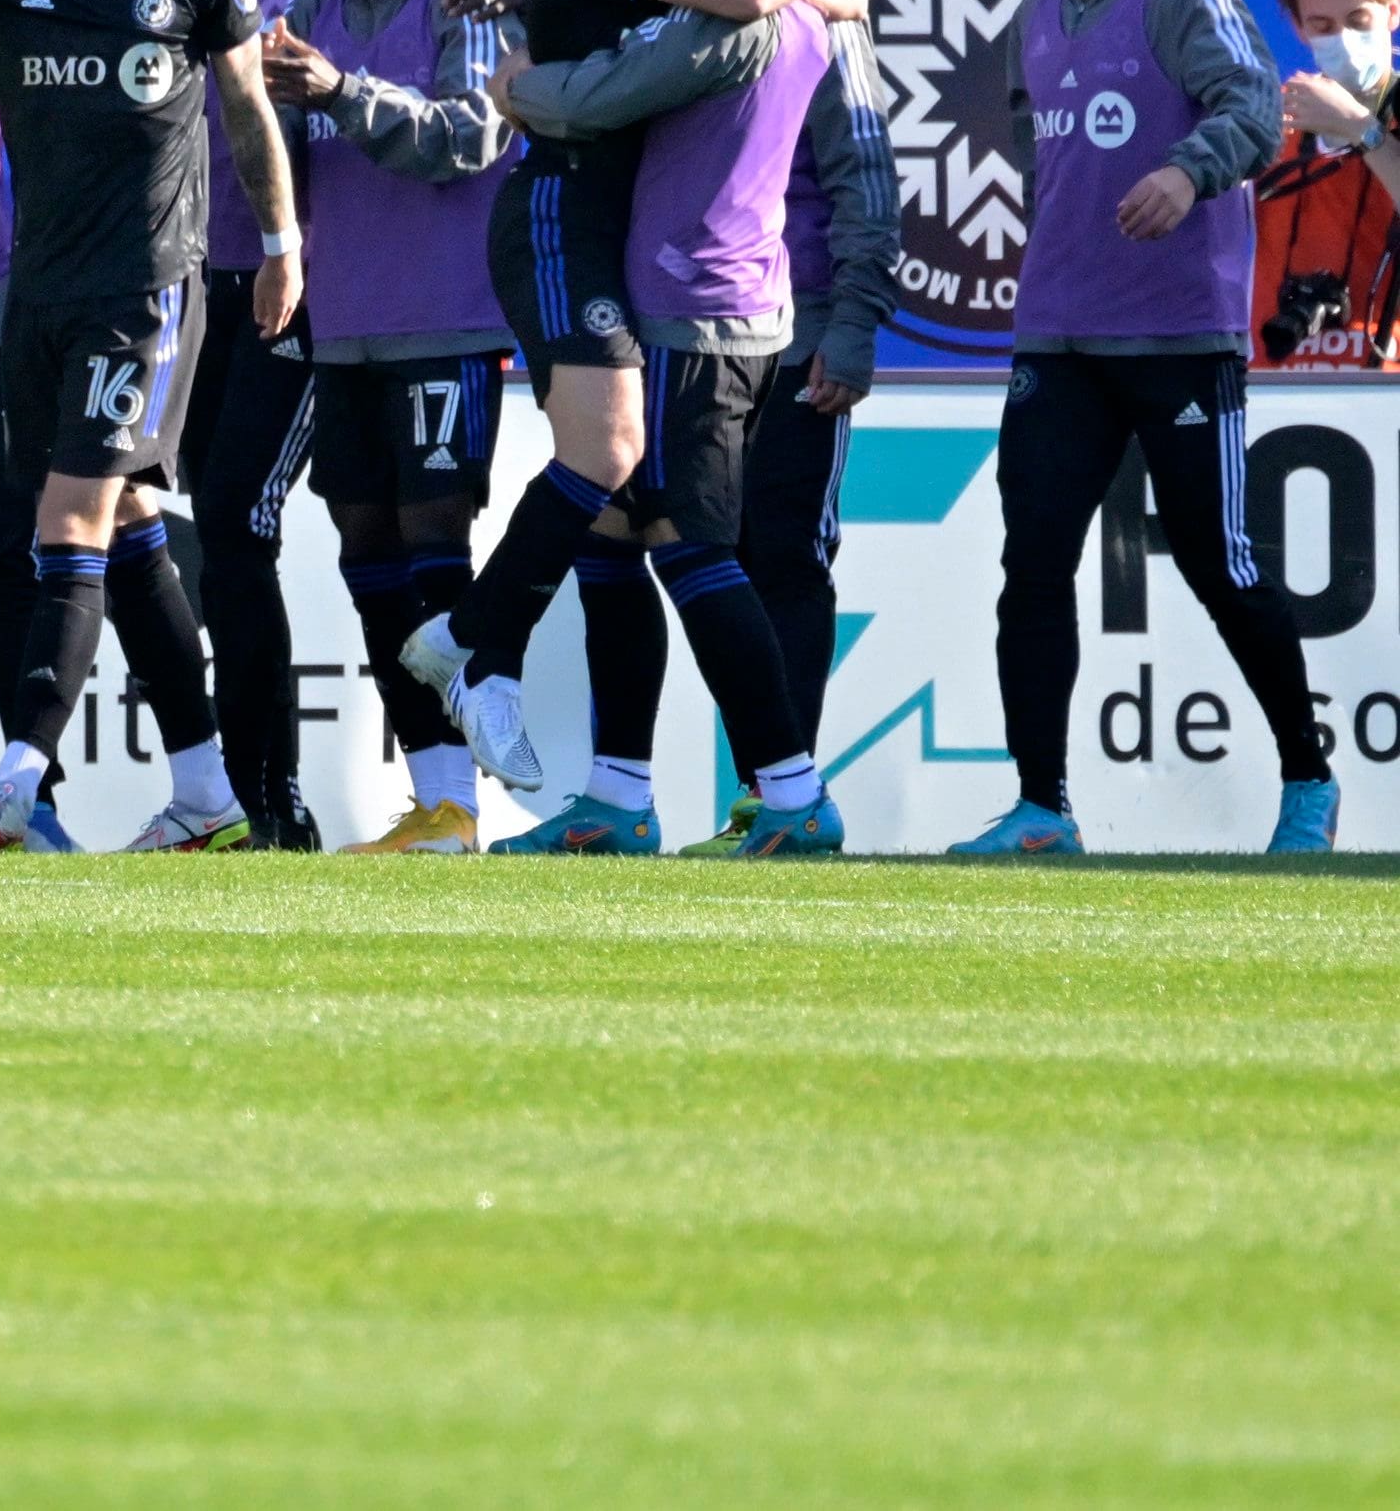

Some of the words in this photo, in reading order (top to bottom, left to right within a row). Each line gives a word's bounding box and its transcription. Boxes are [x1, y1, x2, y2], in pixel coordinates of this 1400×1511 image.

[22, 55, 106, 87] BMO
[84, 355, 145, 426] 16
[408, 380, 462, 447] 17
[1099, 663, 1232, 763] de
